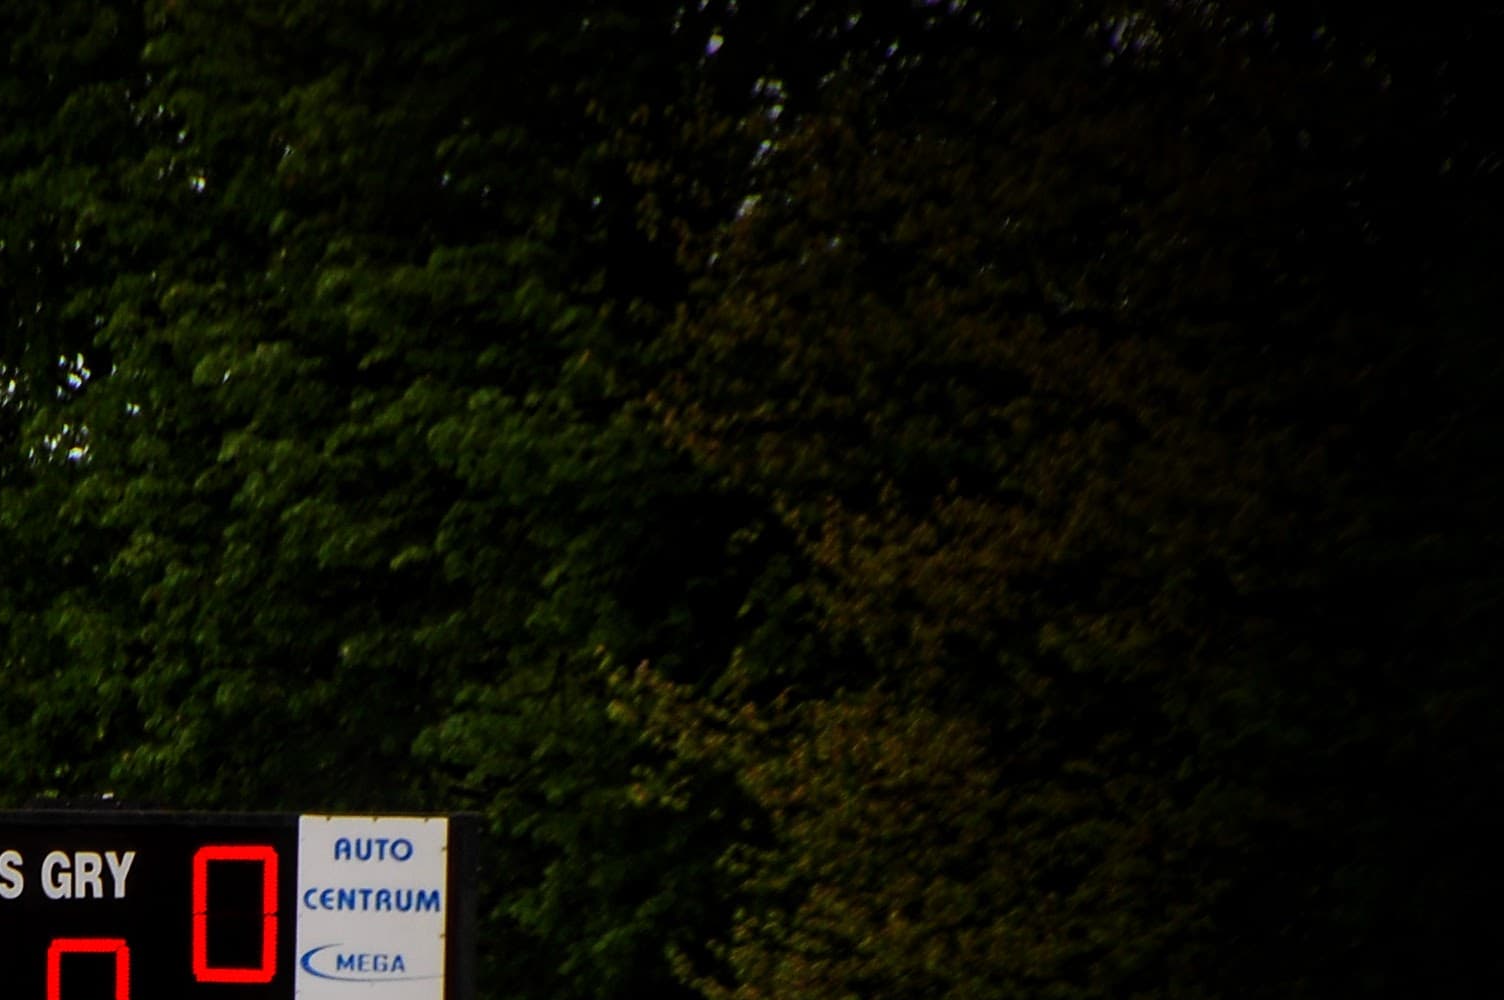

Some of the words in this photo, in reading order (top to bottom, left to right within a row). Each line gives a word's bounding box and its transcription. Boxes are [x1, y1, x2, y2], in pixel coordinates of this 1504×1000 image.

[333, 837, 415, 862] AUTO
[41, 851, 137, 899] GRY
[303, 887, 442, 913] CENTRUM
[193, 845, 278, 983] 0
[335, 953, 406, 974] MEGA
